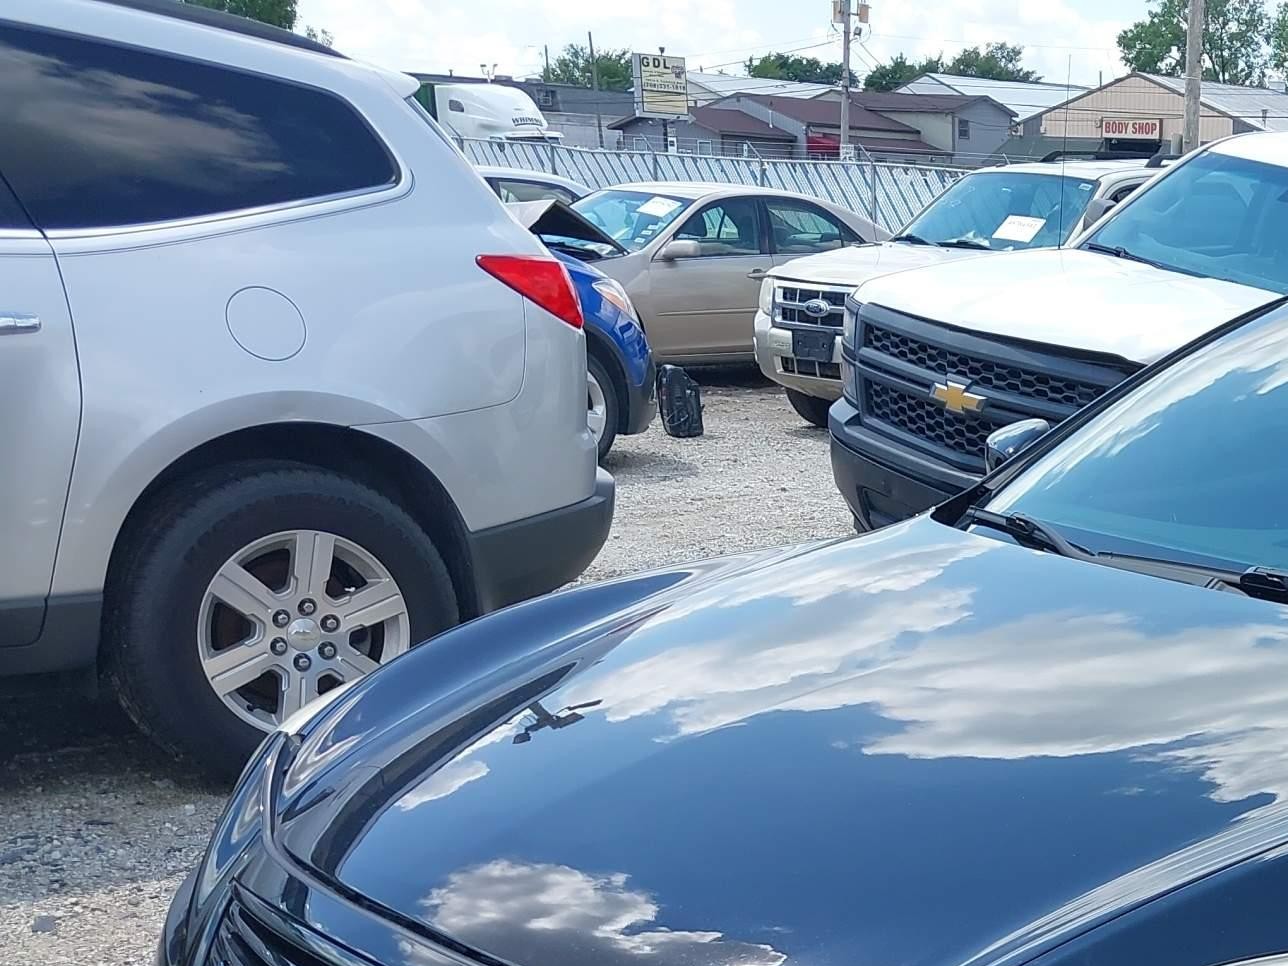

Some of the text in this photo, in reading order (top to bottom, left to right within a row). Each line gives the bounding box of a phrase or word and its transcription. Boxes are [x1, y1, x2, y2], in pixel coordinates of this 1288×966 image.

[641, 56, 670, 70] GDL
[1104, 121, 1157, 135] BODY SHOP
